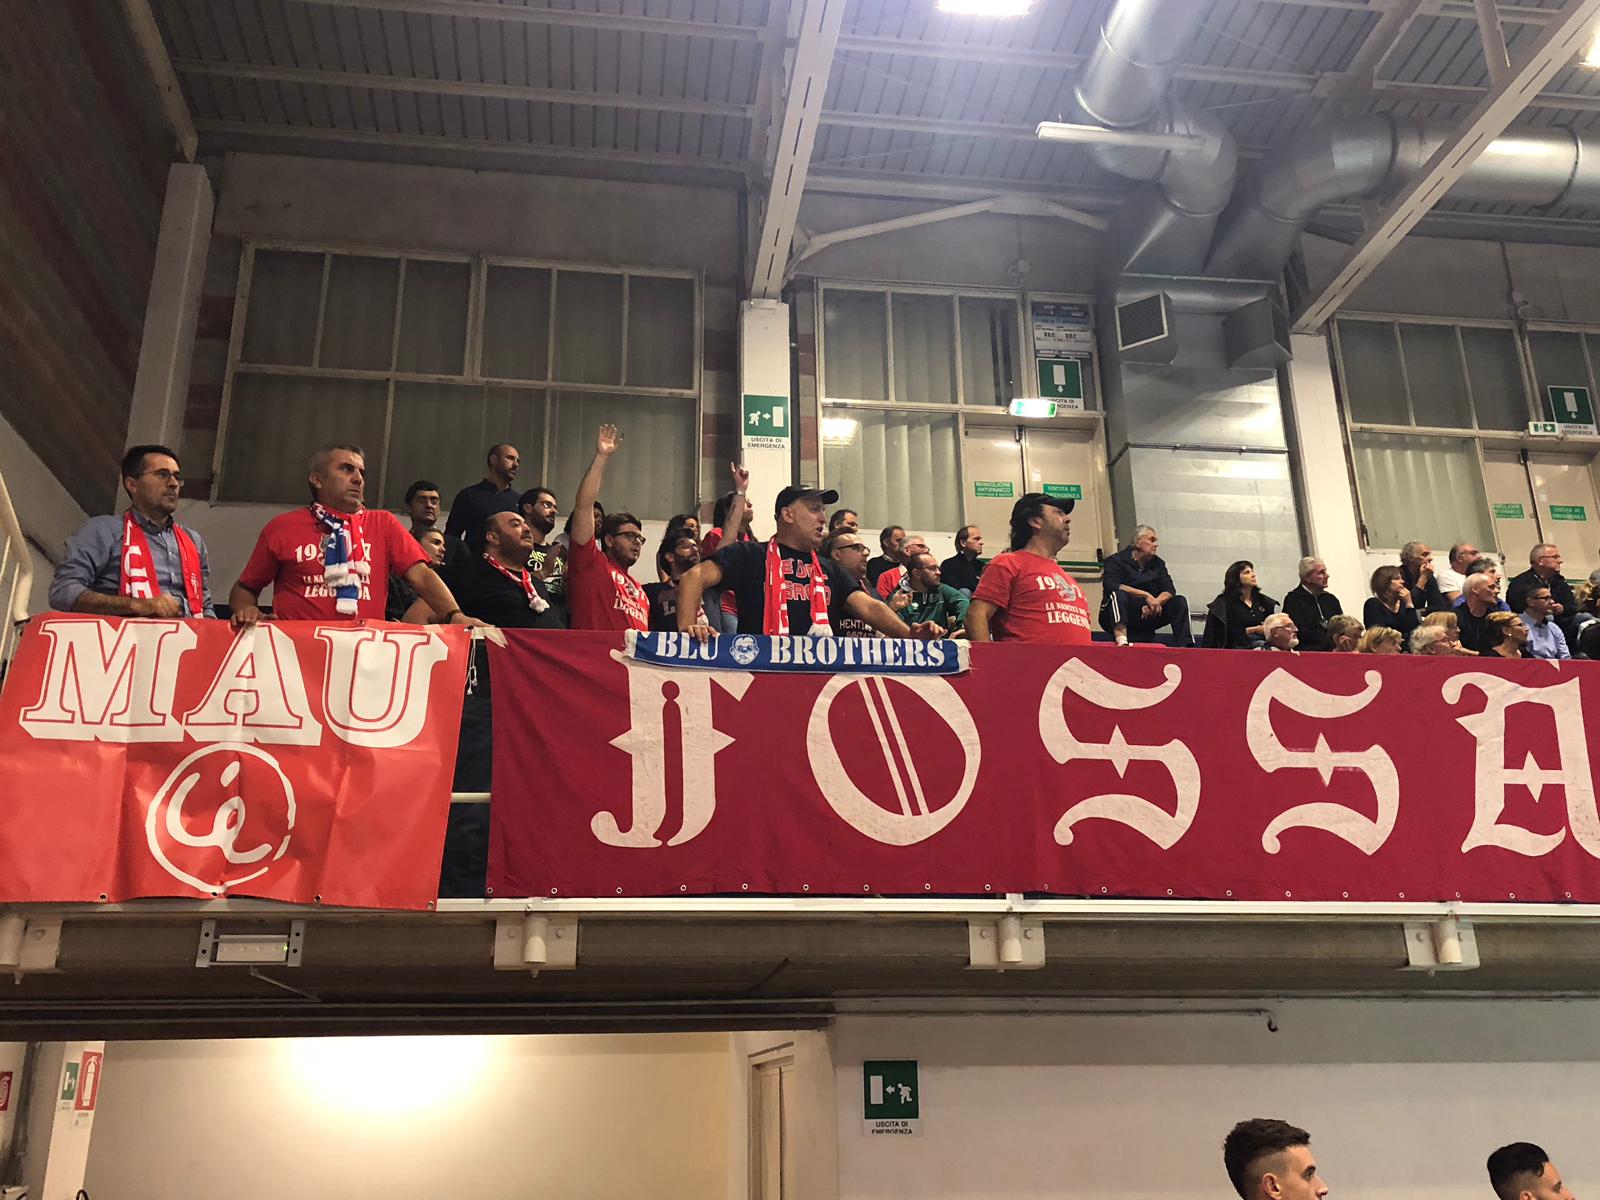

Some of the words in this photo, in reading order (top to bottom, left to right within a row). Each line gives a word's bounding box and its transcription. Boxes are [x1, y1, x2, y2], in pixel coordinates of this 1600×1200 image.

[18, 618, 449, 748] MAU
[656, 631, 720, 661] BLU
[769, 635, 946, 668] BROTHERS
[590, 648, 1600, 860] FOSSA
